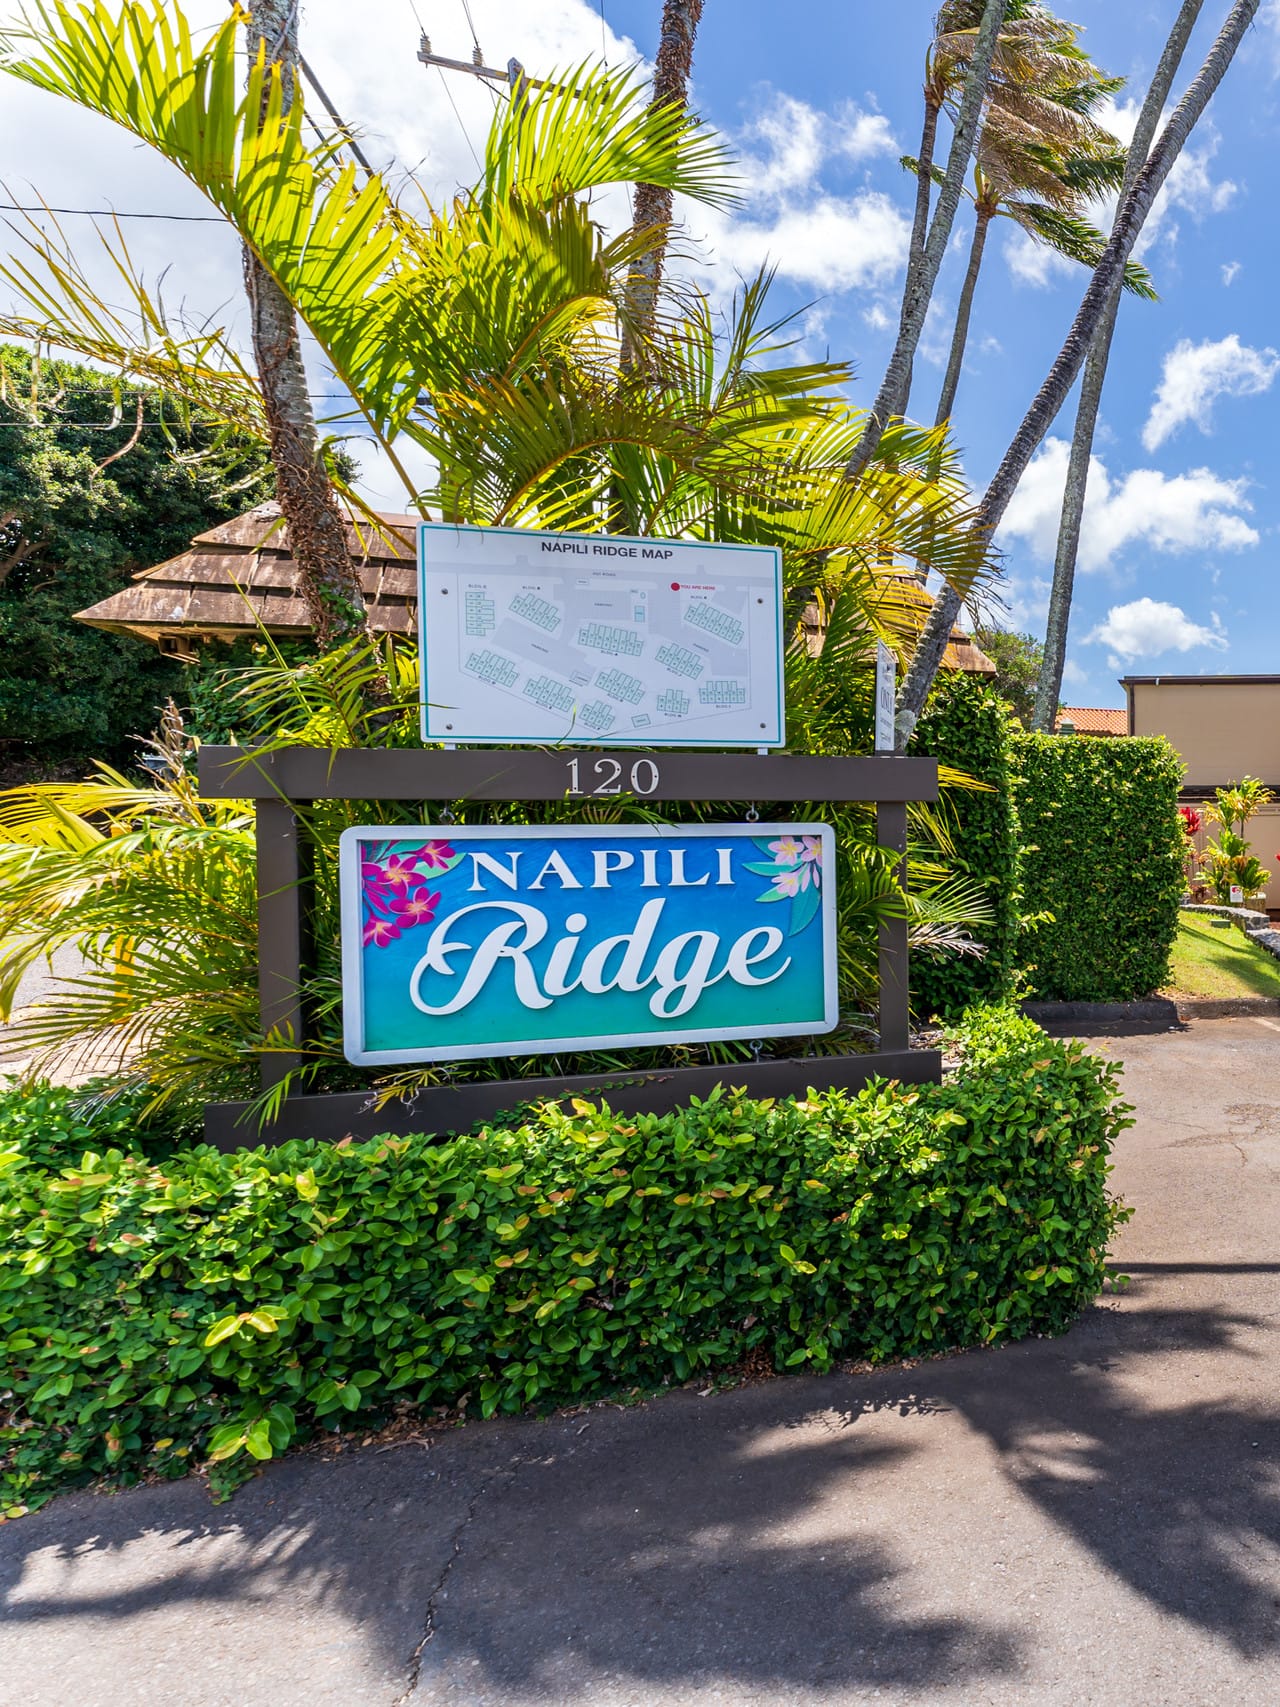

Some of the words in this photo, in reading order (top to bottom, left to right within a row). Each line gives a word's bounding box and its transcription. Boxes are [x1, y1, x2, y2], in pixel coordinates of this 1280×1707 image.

[541, 542, 588, 555] NAPILI
[593, 545, 638, 558] RIDGE
[641, 549, 673, 560] MAP
[566, 757, 660, 795] 120
[467, 847, 736, 892] NAPILI
[409, 897, 792, 1020] Ridge
